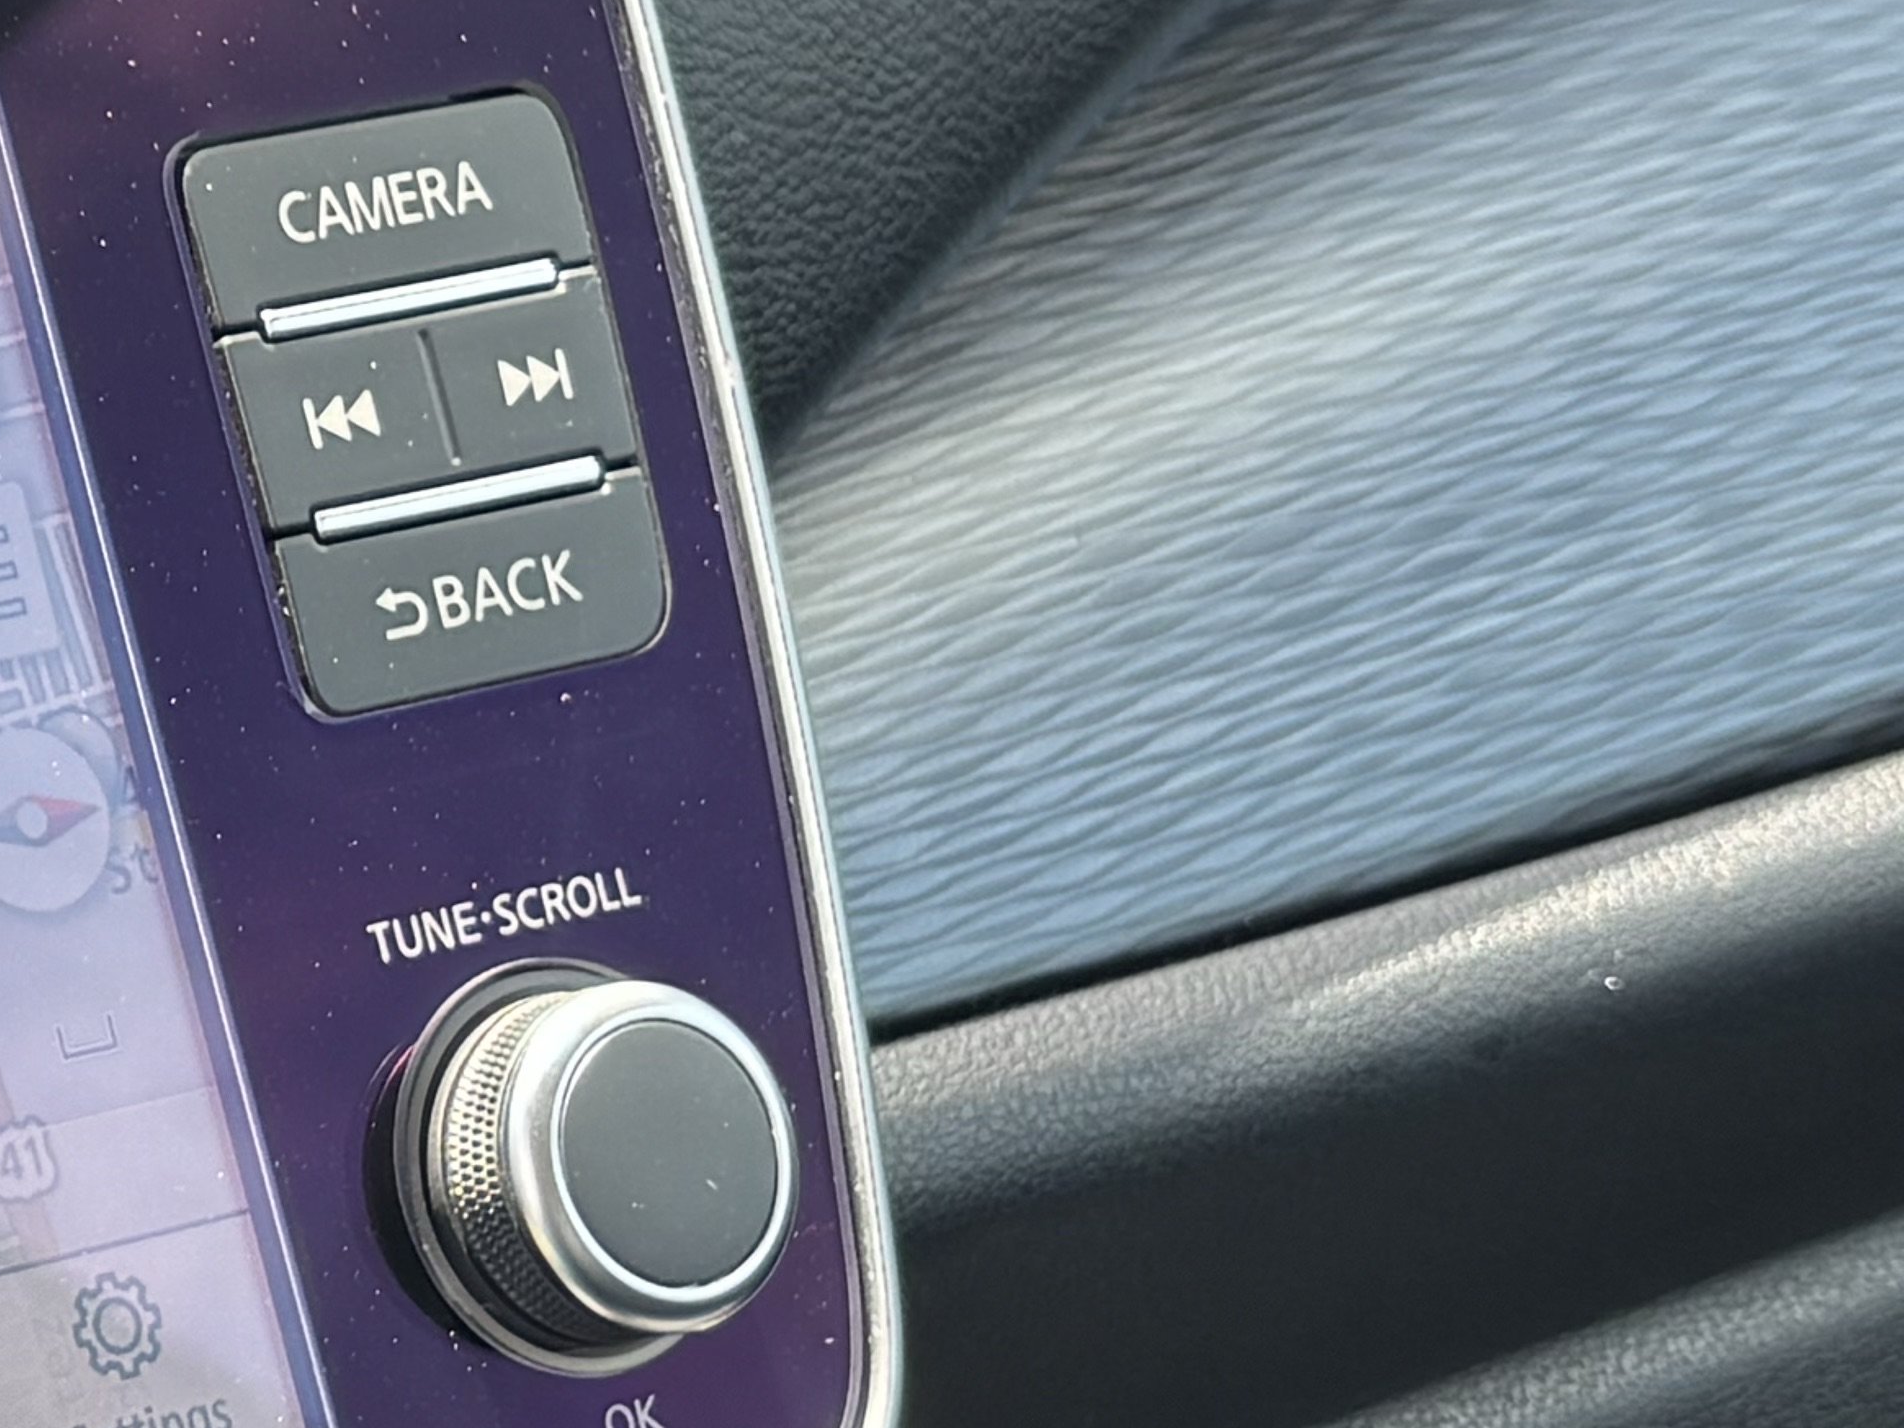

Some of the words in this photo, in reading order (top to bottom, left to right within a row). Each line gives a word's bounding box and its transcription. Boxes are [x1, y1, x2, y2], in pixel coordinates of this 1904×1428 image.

[278, 161, 492, 244] CAMERA
[431, 550, 583, 630] BACK
[0, 1135, 44, 1181] 41
